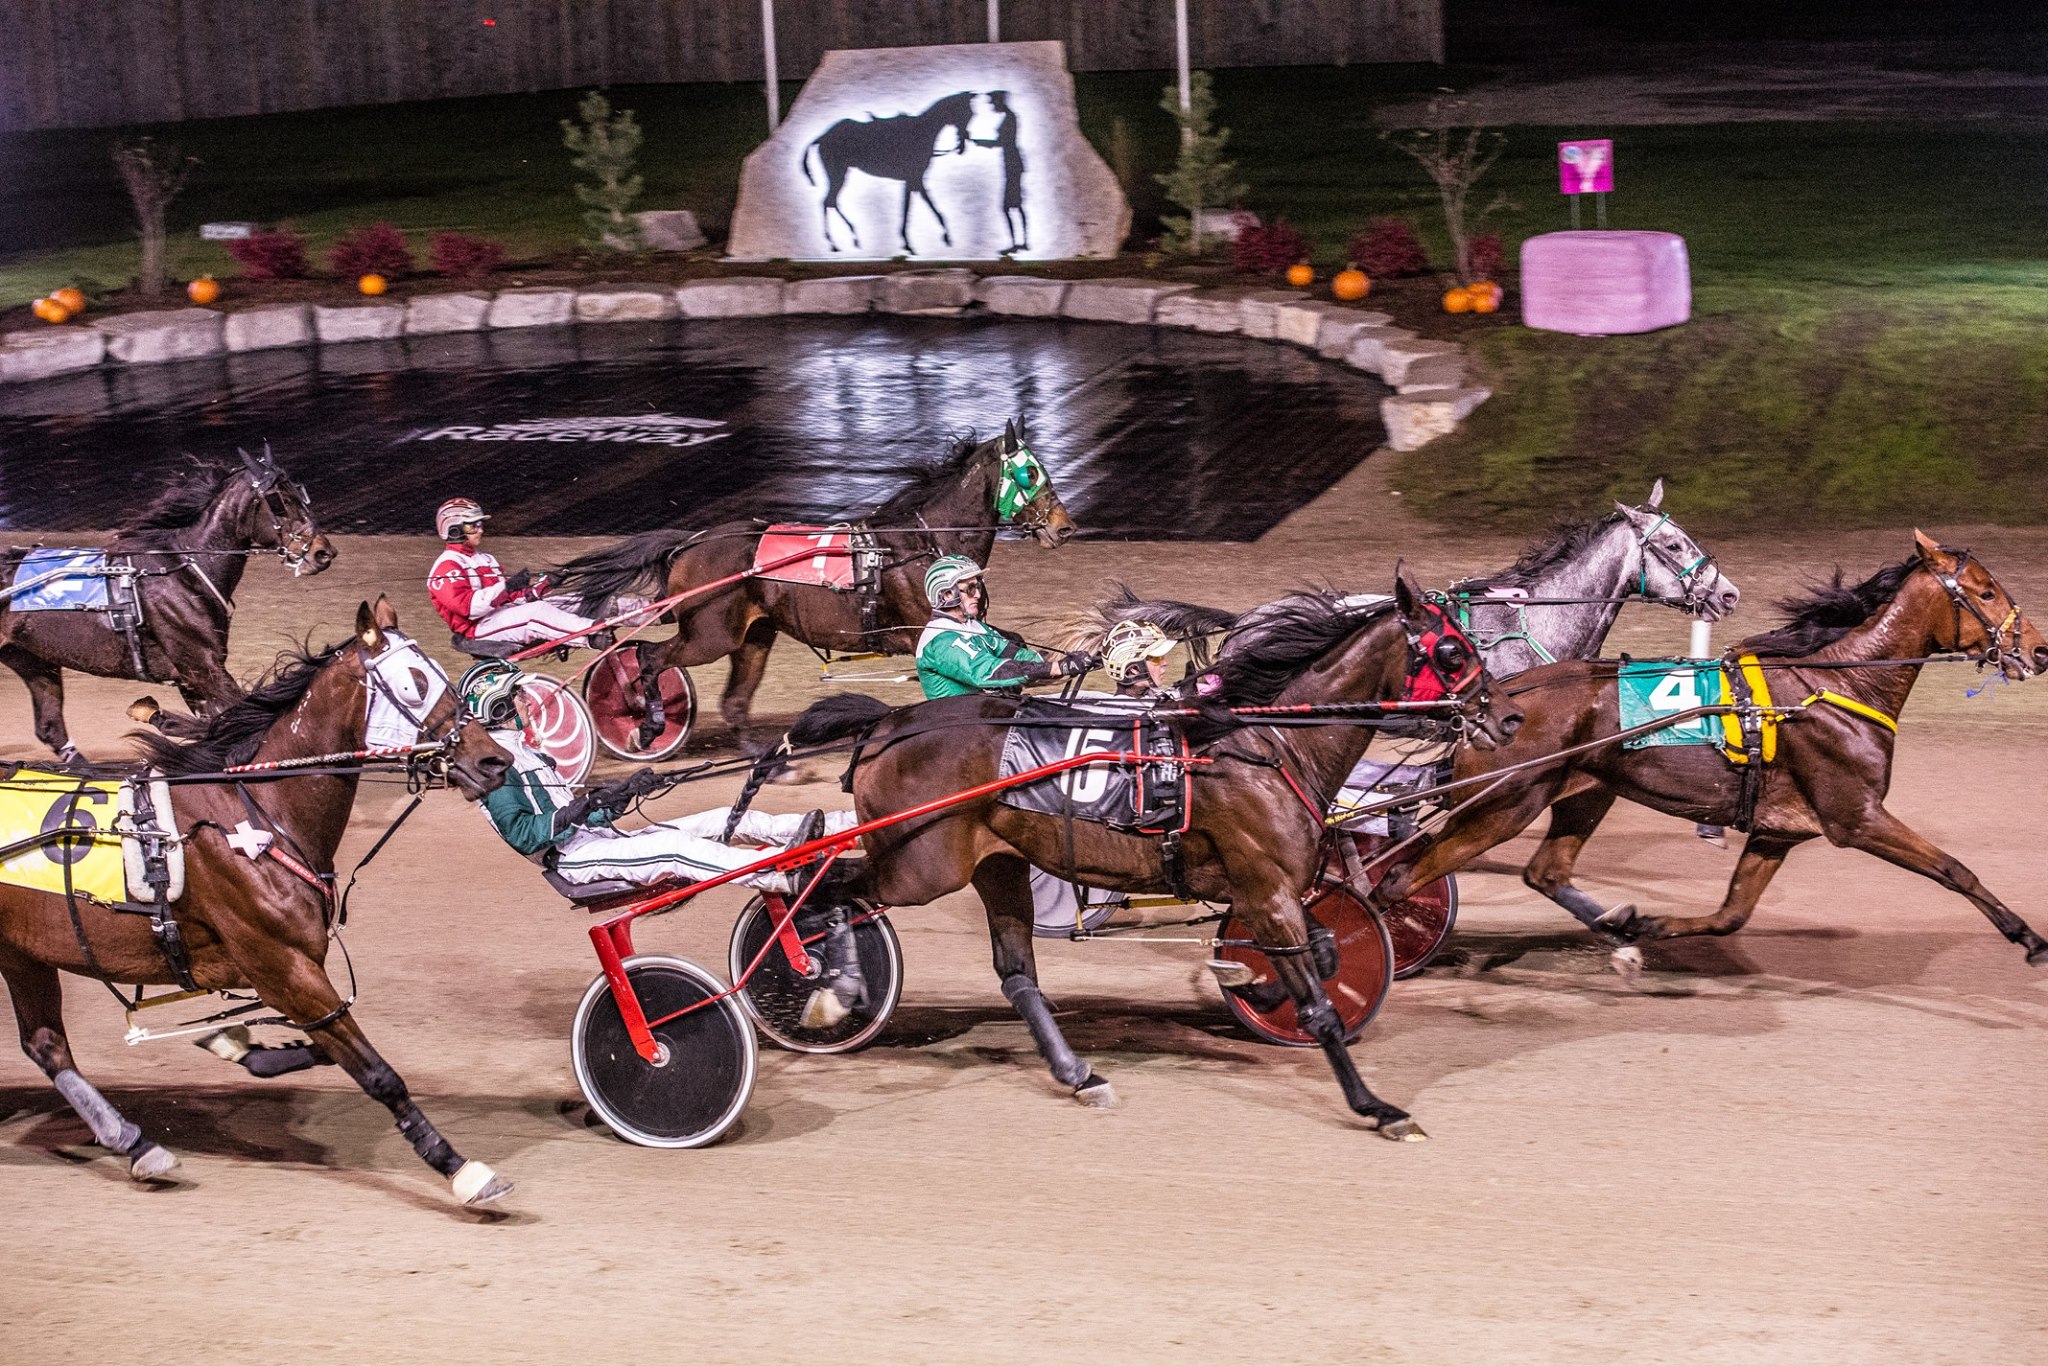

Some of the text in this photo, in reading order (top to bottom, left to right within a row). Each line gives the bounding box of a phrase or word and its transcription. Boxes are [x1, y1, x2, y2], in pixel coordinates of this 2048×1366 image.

[417, 425, 732, 446] Raceway
[806, 527, 835, 569] 1
[1648, 668, 1702, 729] 4
[39, 786, 109, 865] 6
